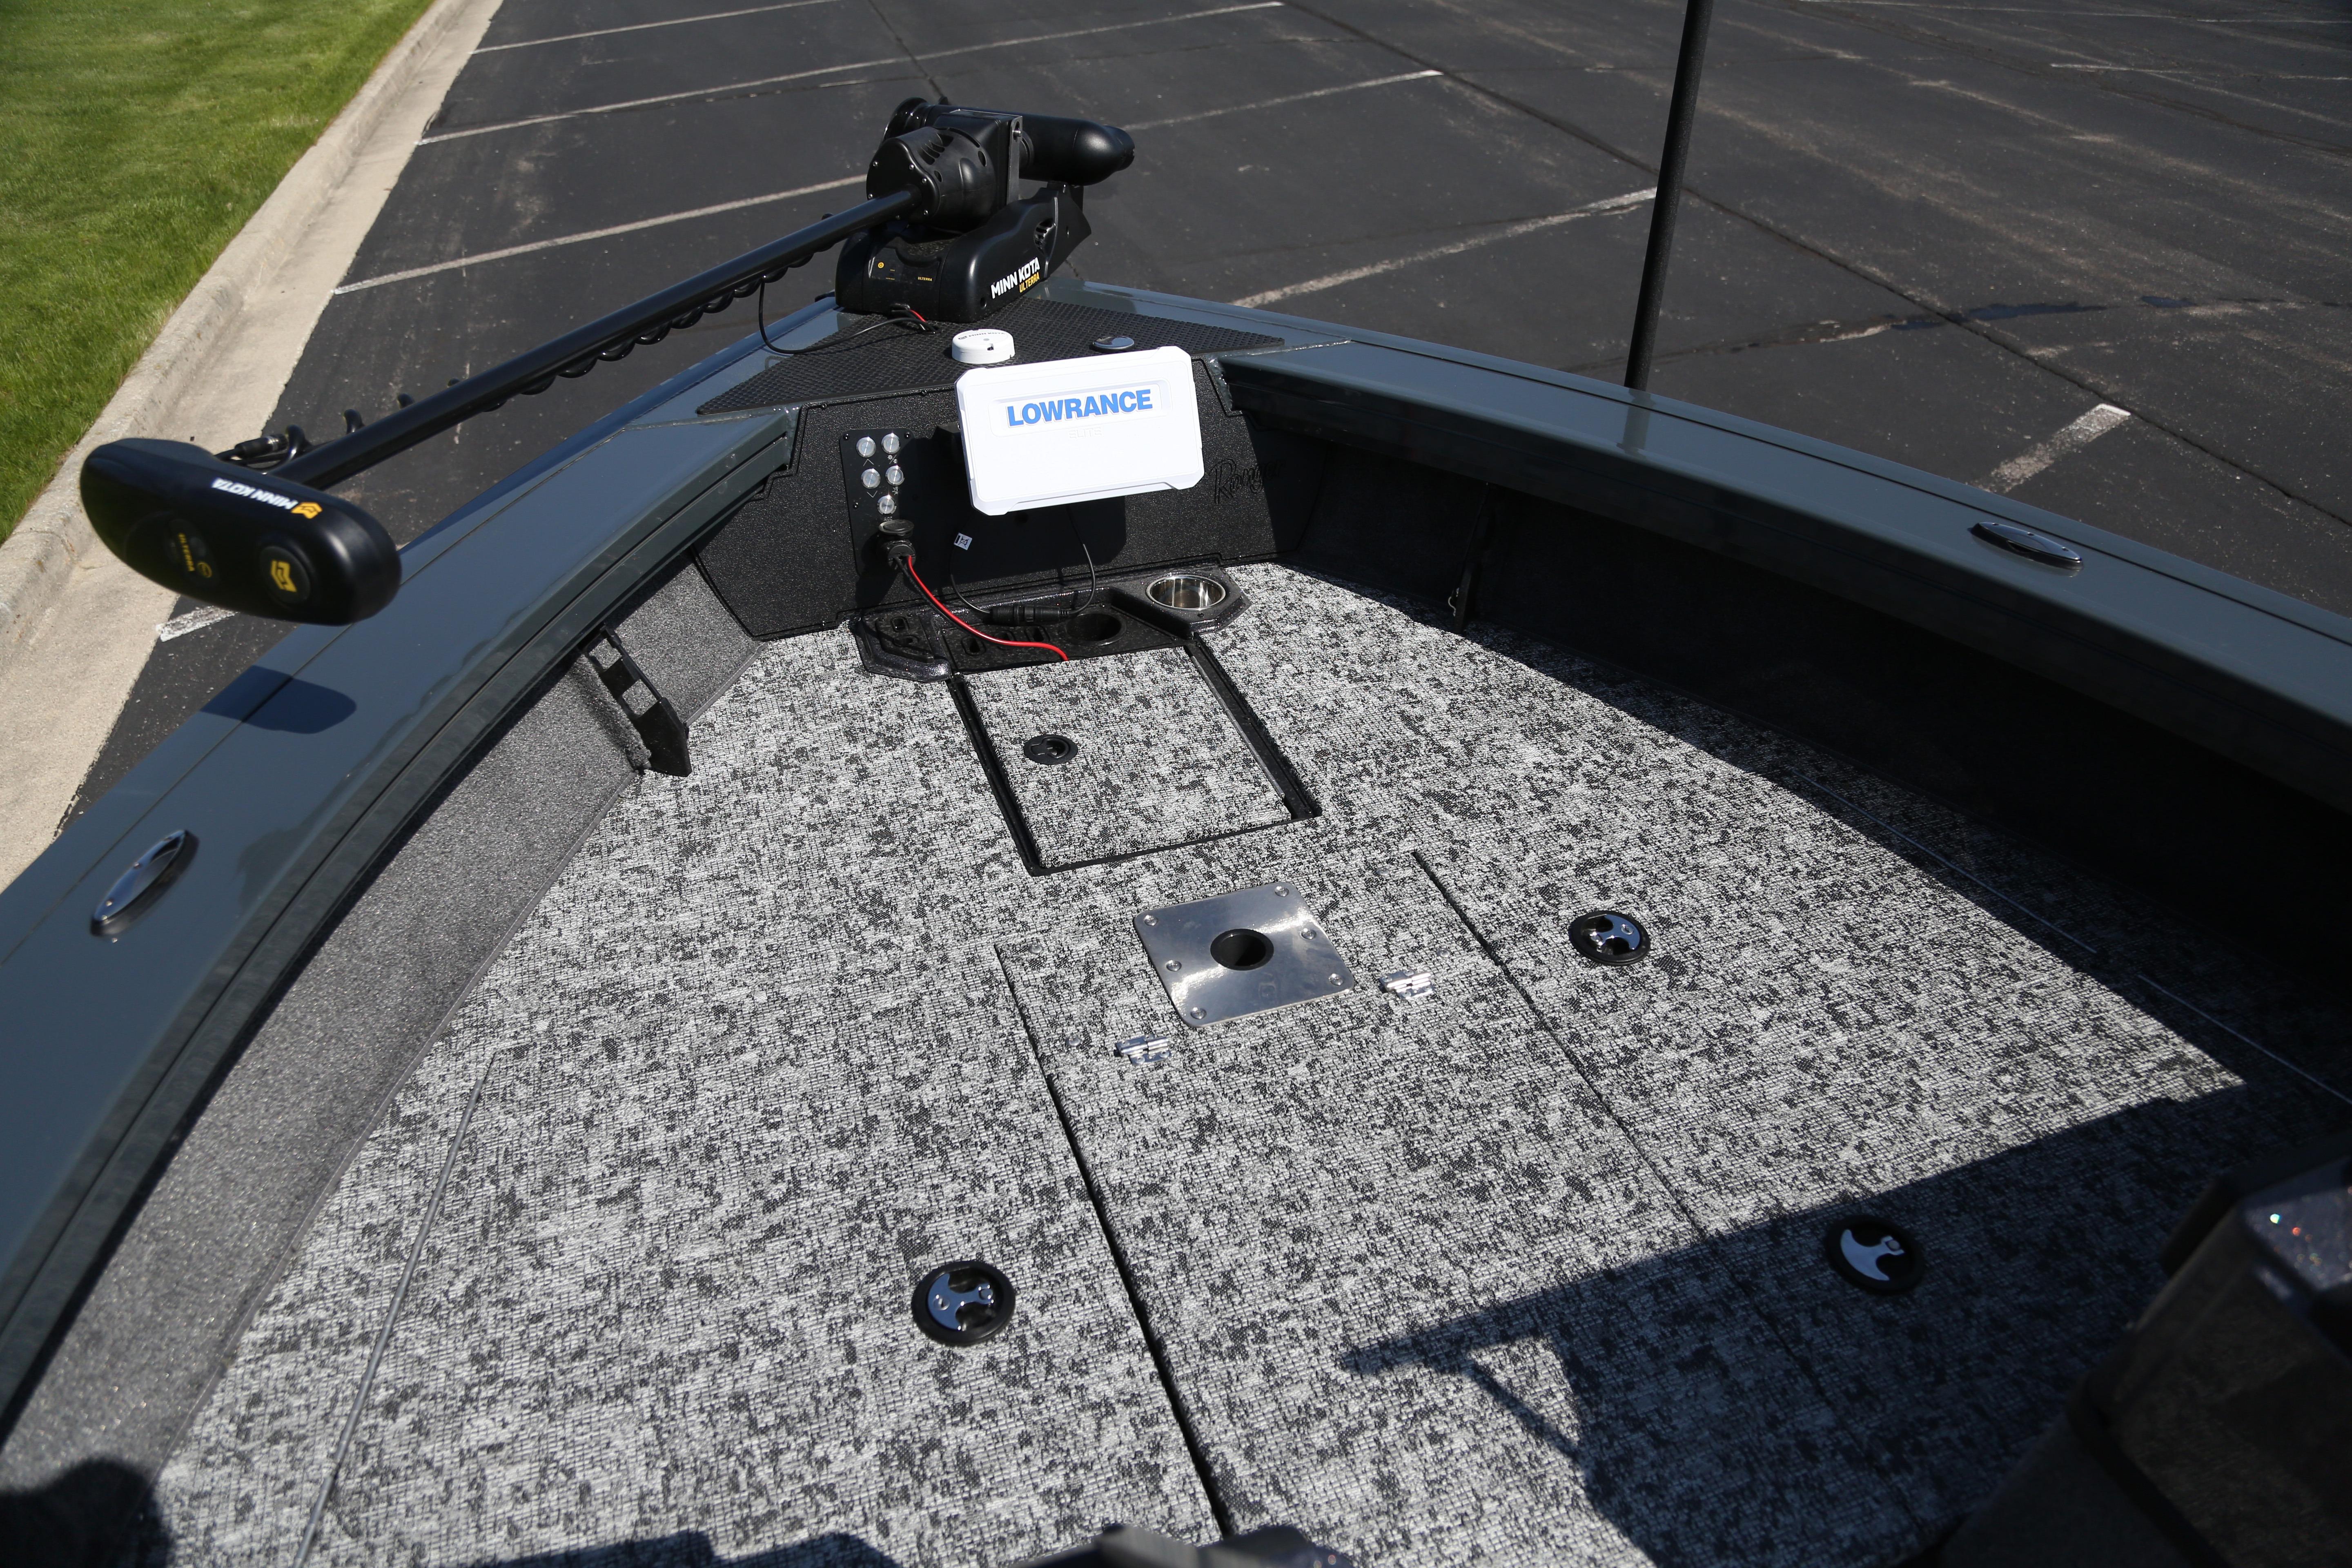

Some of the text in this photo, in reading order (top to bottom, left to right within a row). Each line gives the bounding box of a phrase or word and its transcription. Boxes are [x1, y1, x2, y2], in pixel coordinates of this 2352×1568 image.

[991, 257, 1040, 299] MINN KOTA
[1019, 272, 1040, 293] ULTERRA
[1007, 389, 1153, 427] LOWRANCE
[1068, 427, 1102, 439] ELITE
[212, 477, 298, 510] MINN KOTA
